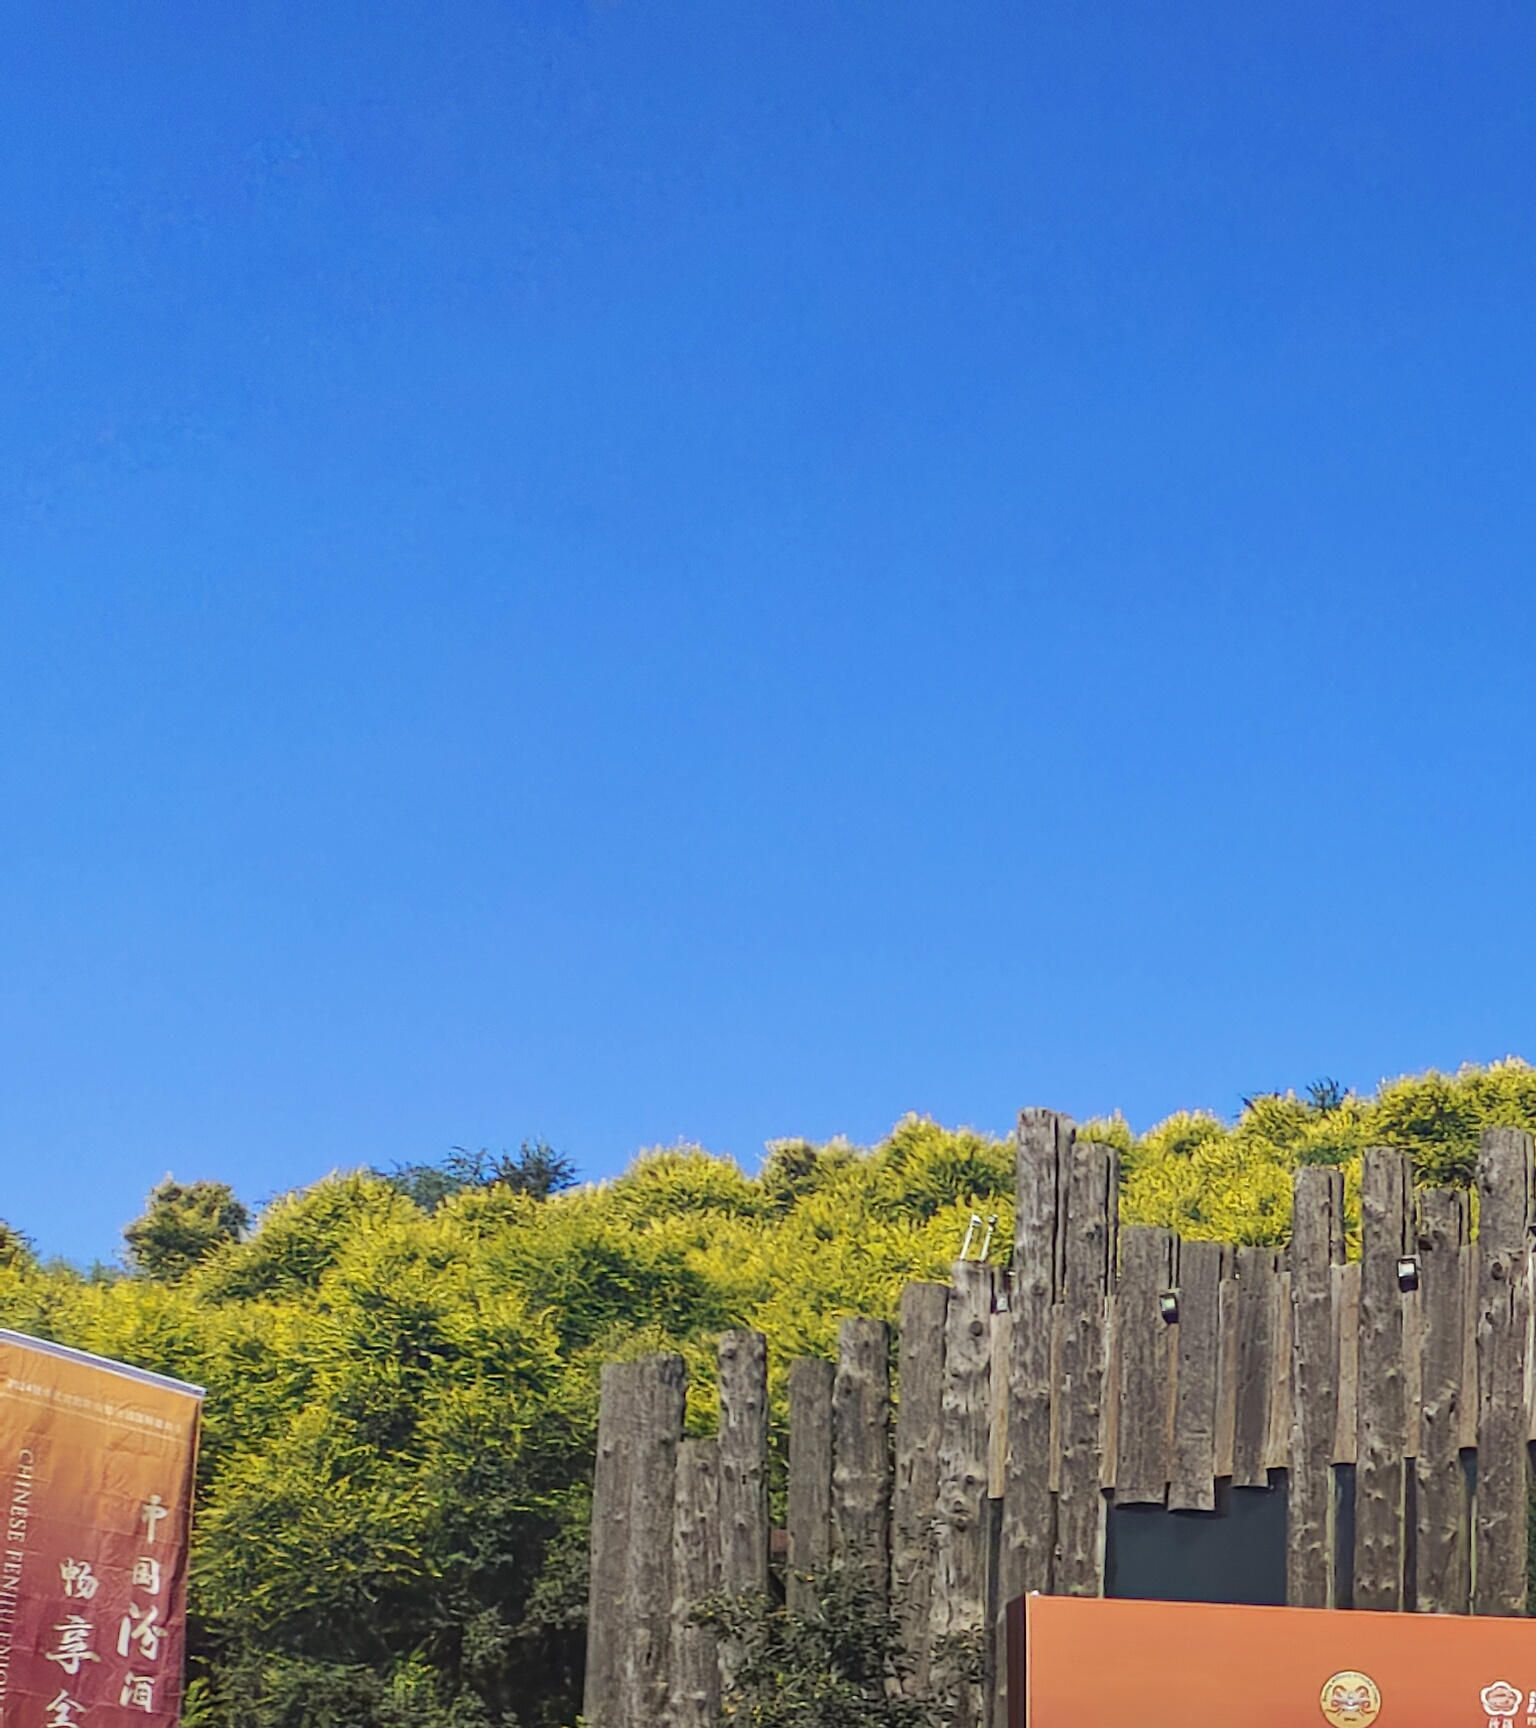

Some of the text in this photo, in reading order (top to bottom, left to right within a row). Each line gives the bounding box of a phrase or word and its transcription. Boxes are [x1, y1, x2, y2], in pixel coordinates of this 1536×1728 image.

[7, 1449, 34, 1543] CHINESE
[117, 1494, 168, 1714] 中国汾酒
